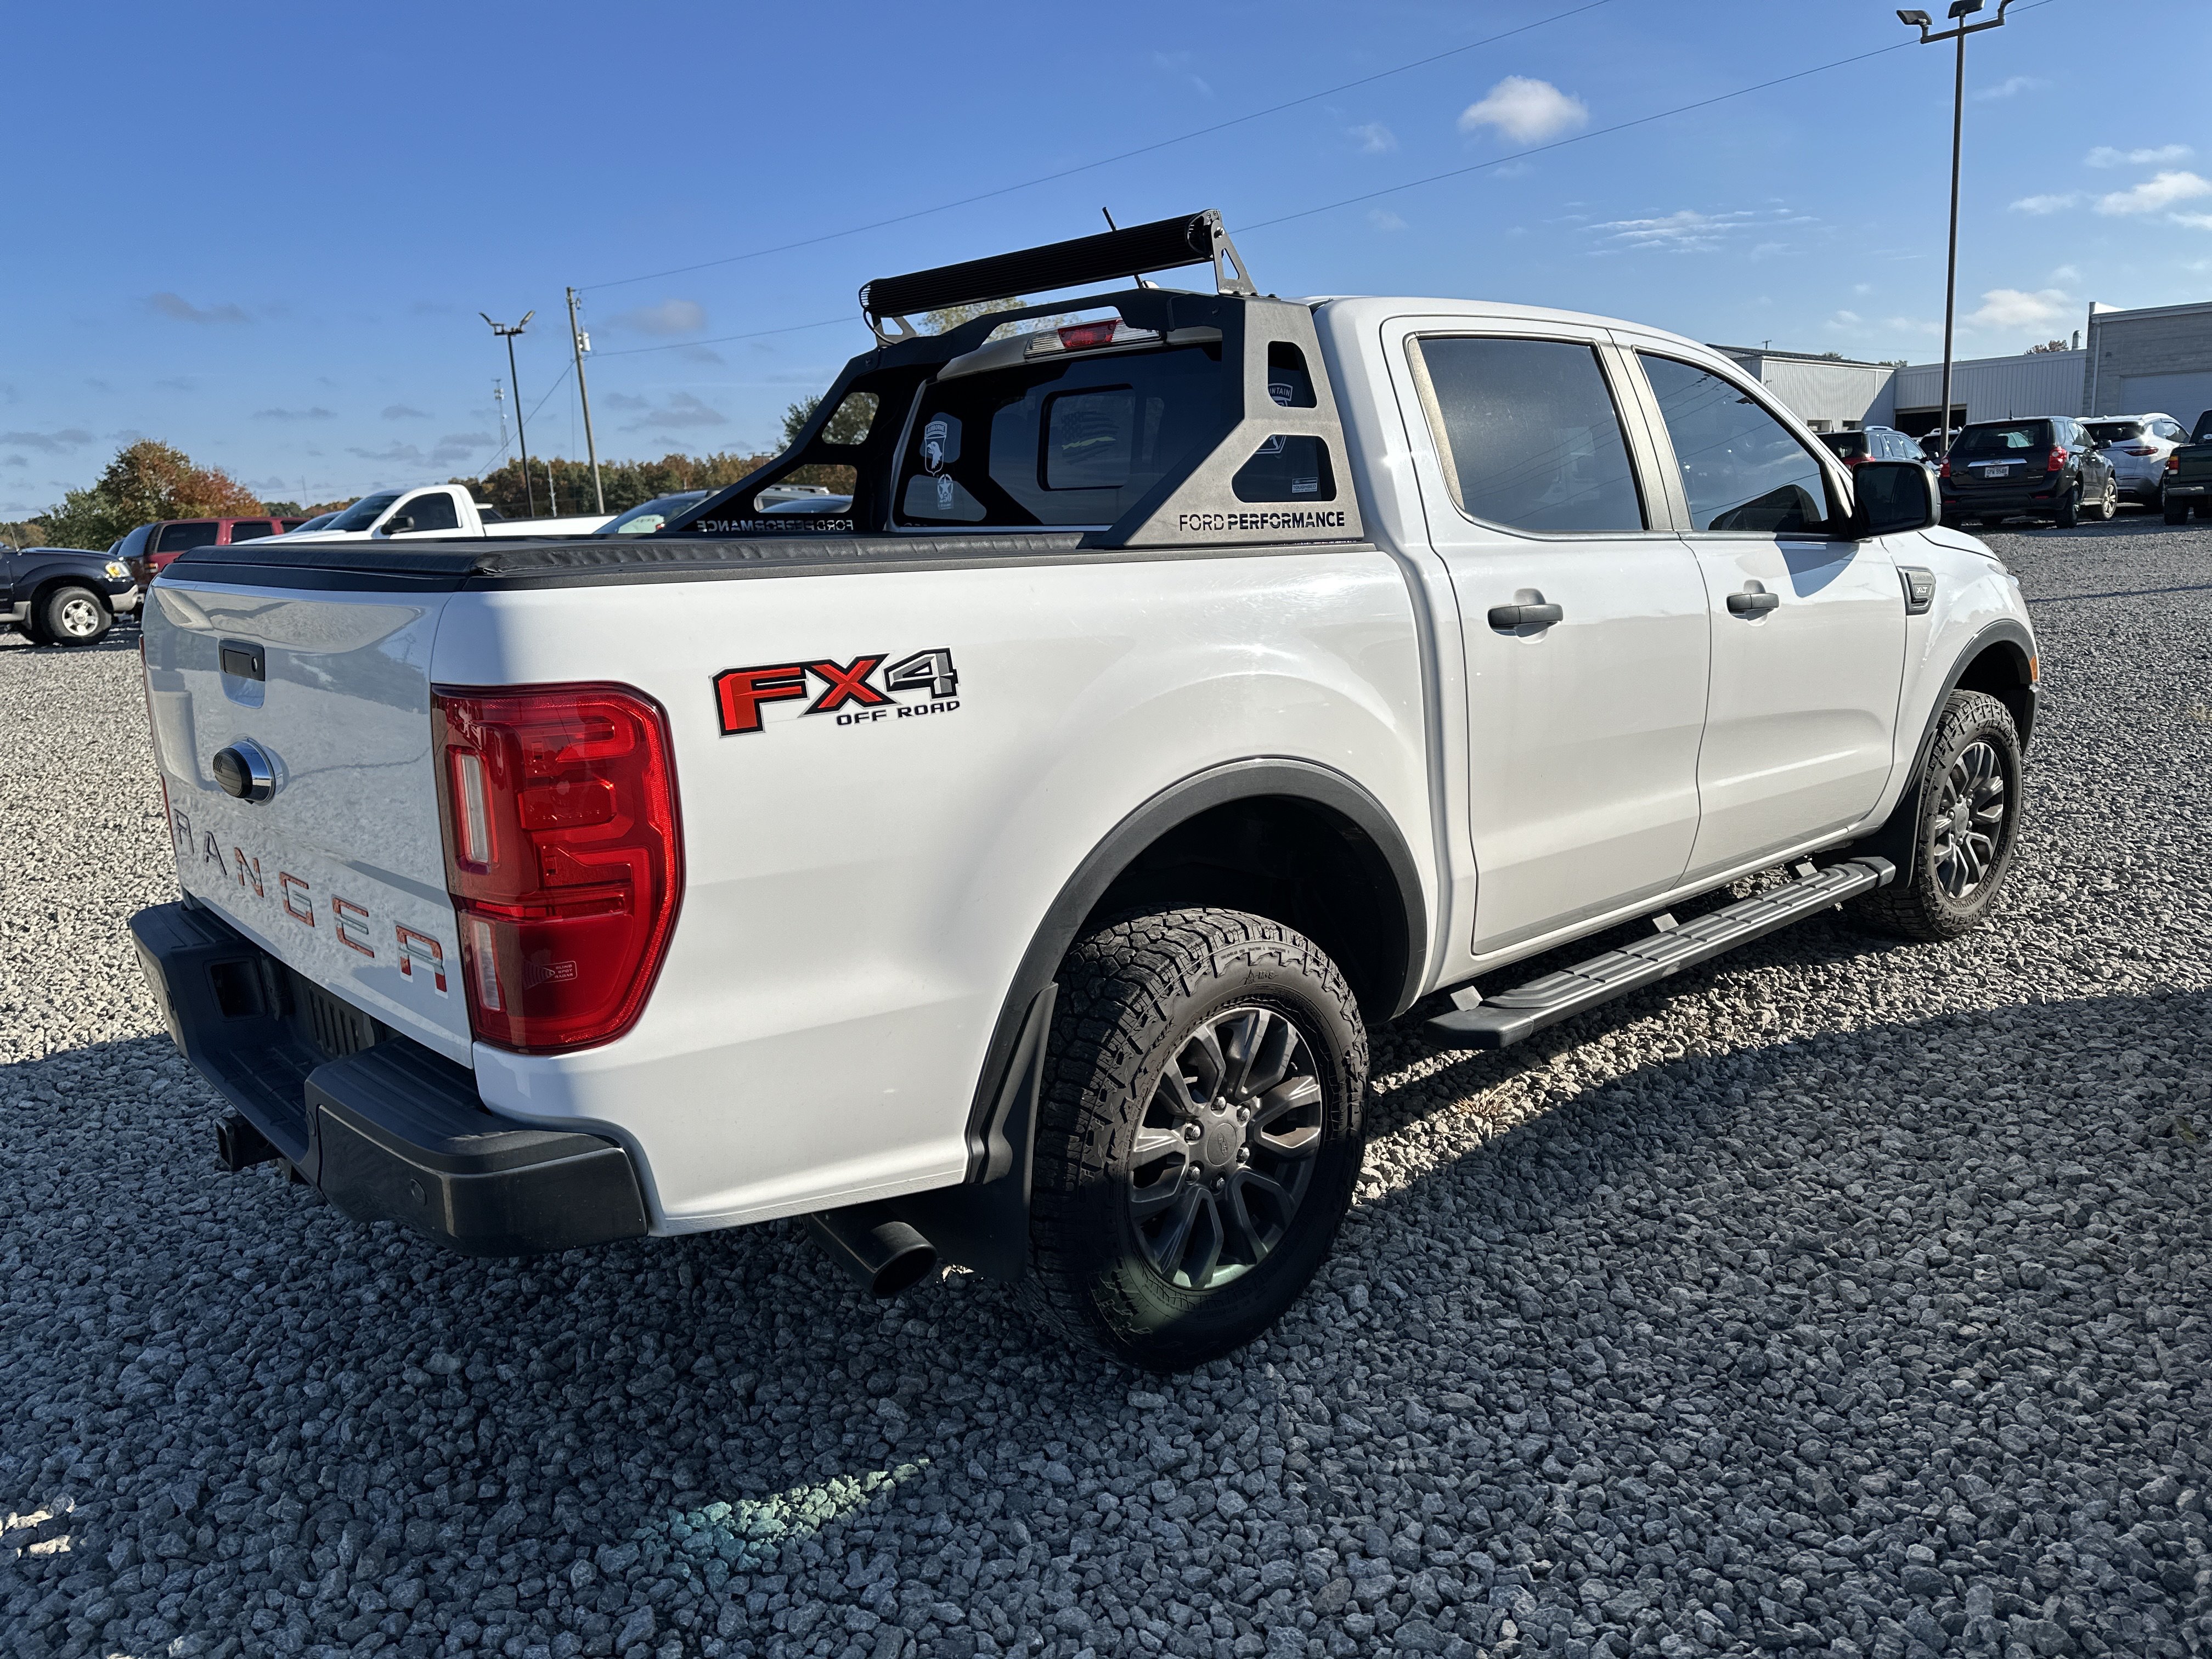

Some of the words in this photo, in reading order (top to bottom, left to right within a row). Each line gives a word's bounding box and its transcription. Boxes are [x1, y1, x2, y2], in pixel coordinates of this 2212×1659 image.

[939, 493, 952, 503] 250
[1179, 514, 1224, 531] FORD
[1227, 511, 1345, 529] PERFORMANCE
[710, 646, 959, 738] FX4
[836, 711, 887, 726] OFF
[897, 700, 960, 719] ROAD
[173, 808, 448, 994] RANGER
